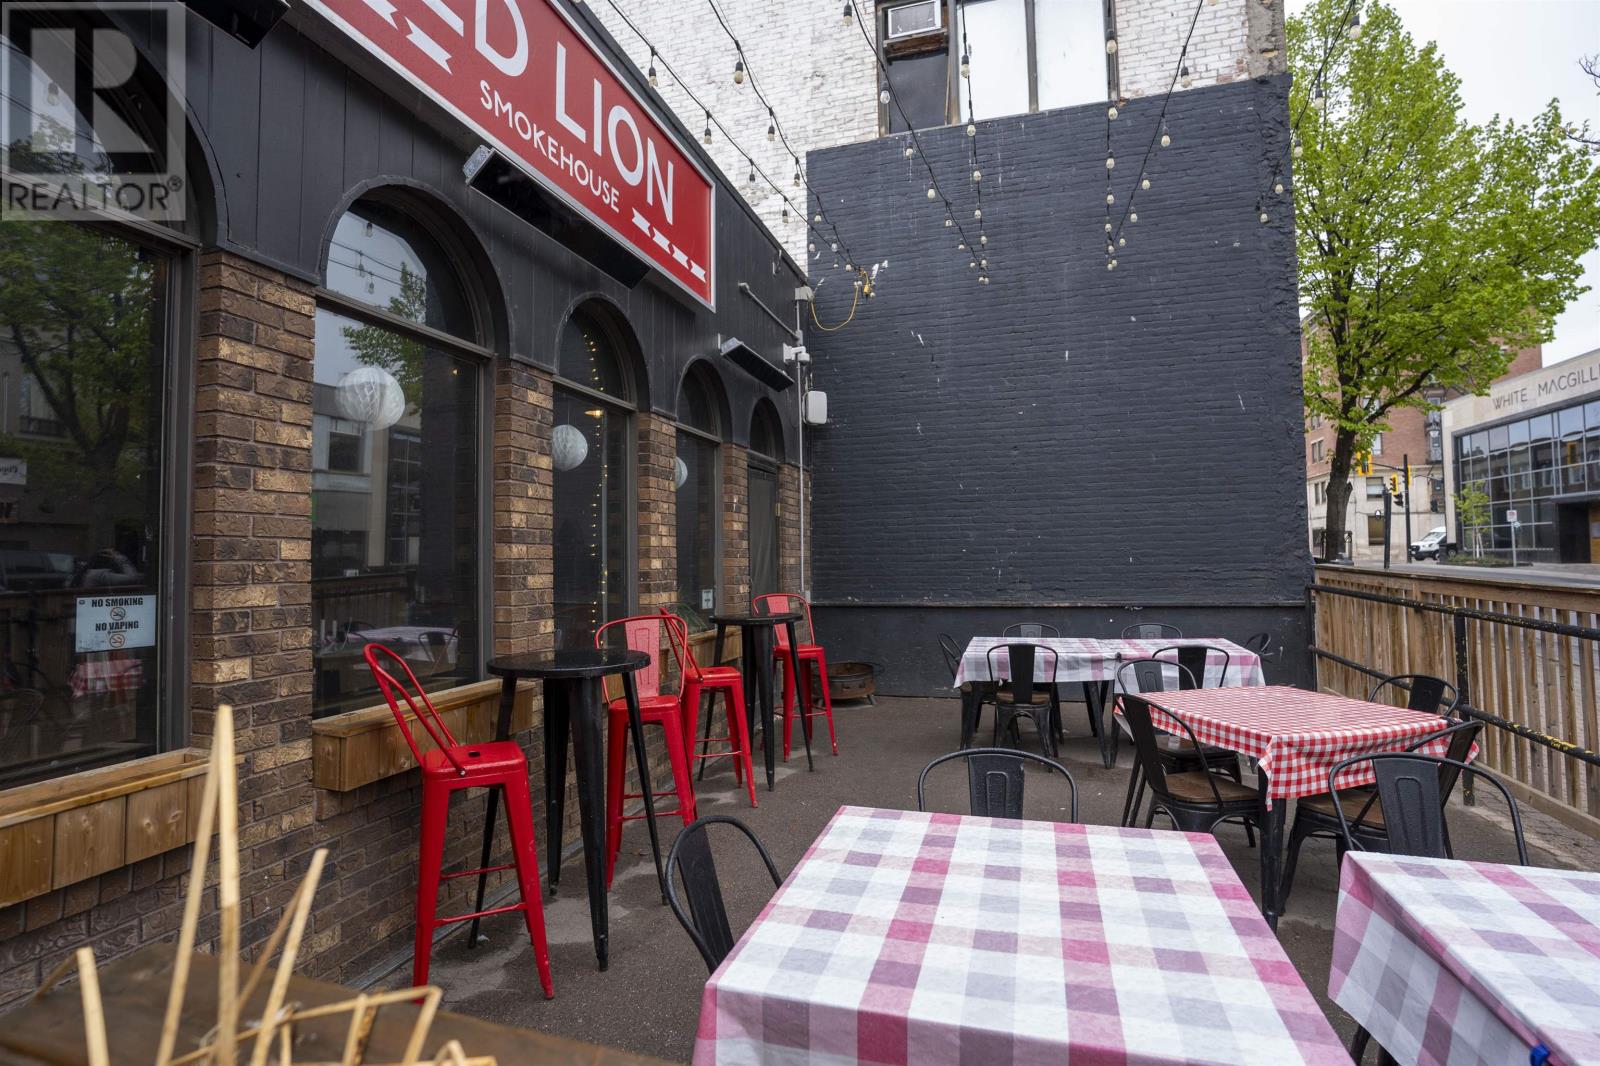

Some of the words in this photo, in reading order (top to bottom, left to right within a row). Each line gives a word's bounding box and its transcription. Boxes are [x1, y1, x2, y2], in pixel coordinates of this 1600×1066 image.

[480, 79, 620, 214] SMOKEHOUSE
[555, 41, 674, 225] LION
[1492, 388, 1528, 410] WHITE
[1537, 363, 1600, 397] MACGILL
[91, 599, 104, 608] NO
[105, 597, 144, 607] SMOKING
[95, 622, 107, 631] NO
[108, 620, 139, 630] VAPING
